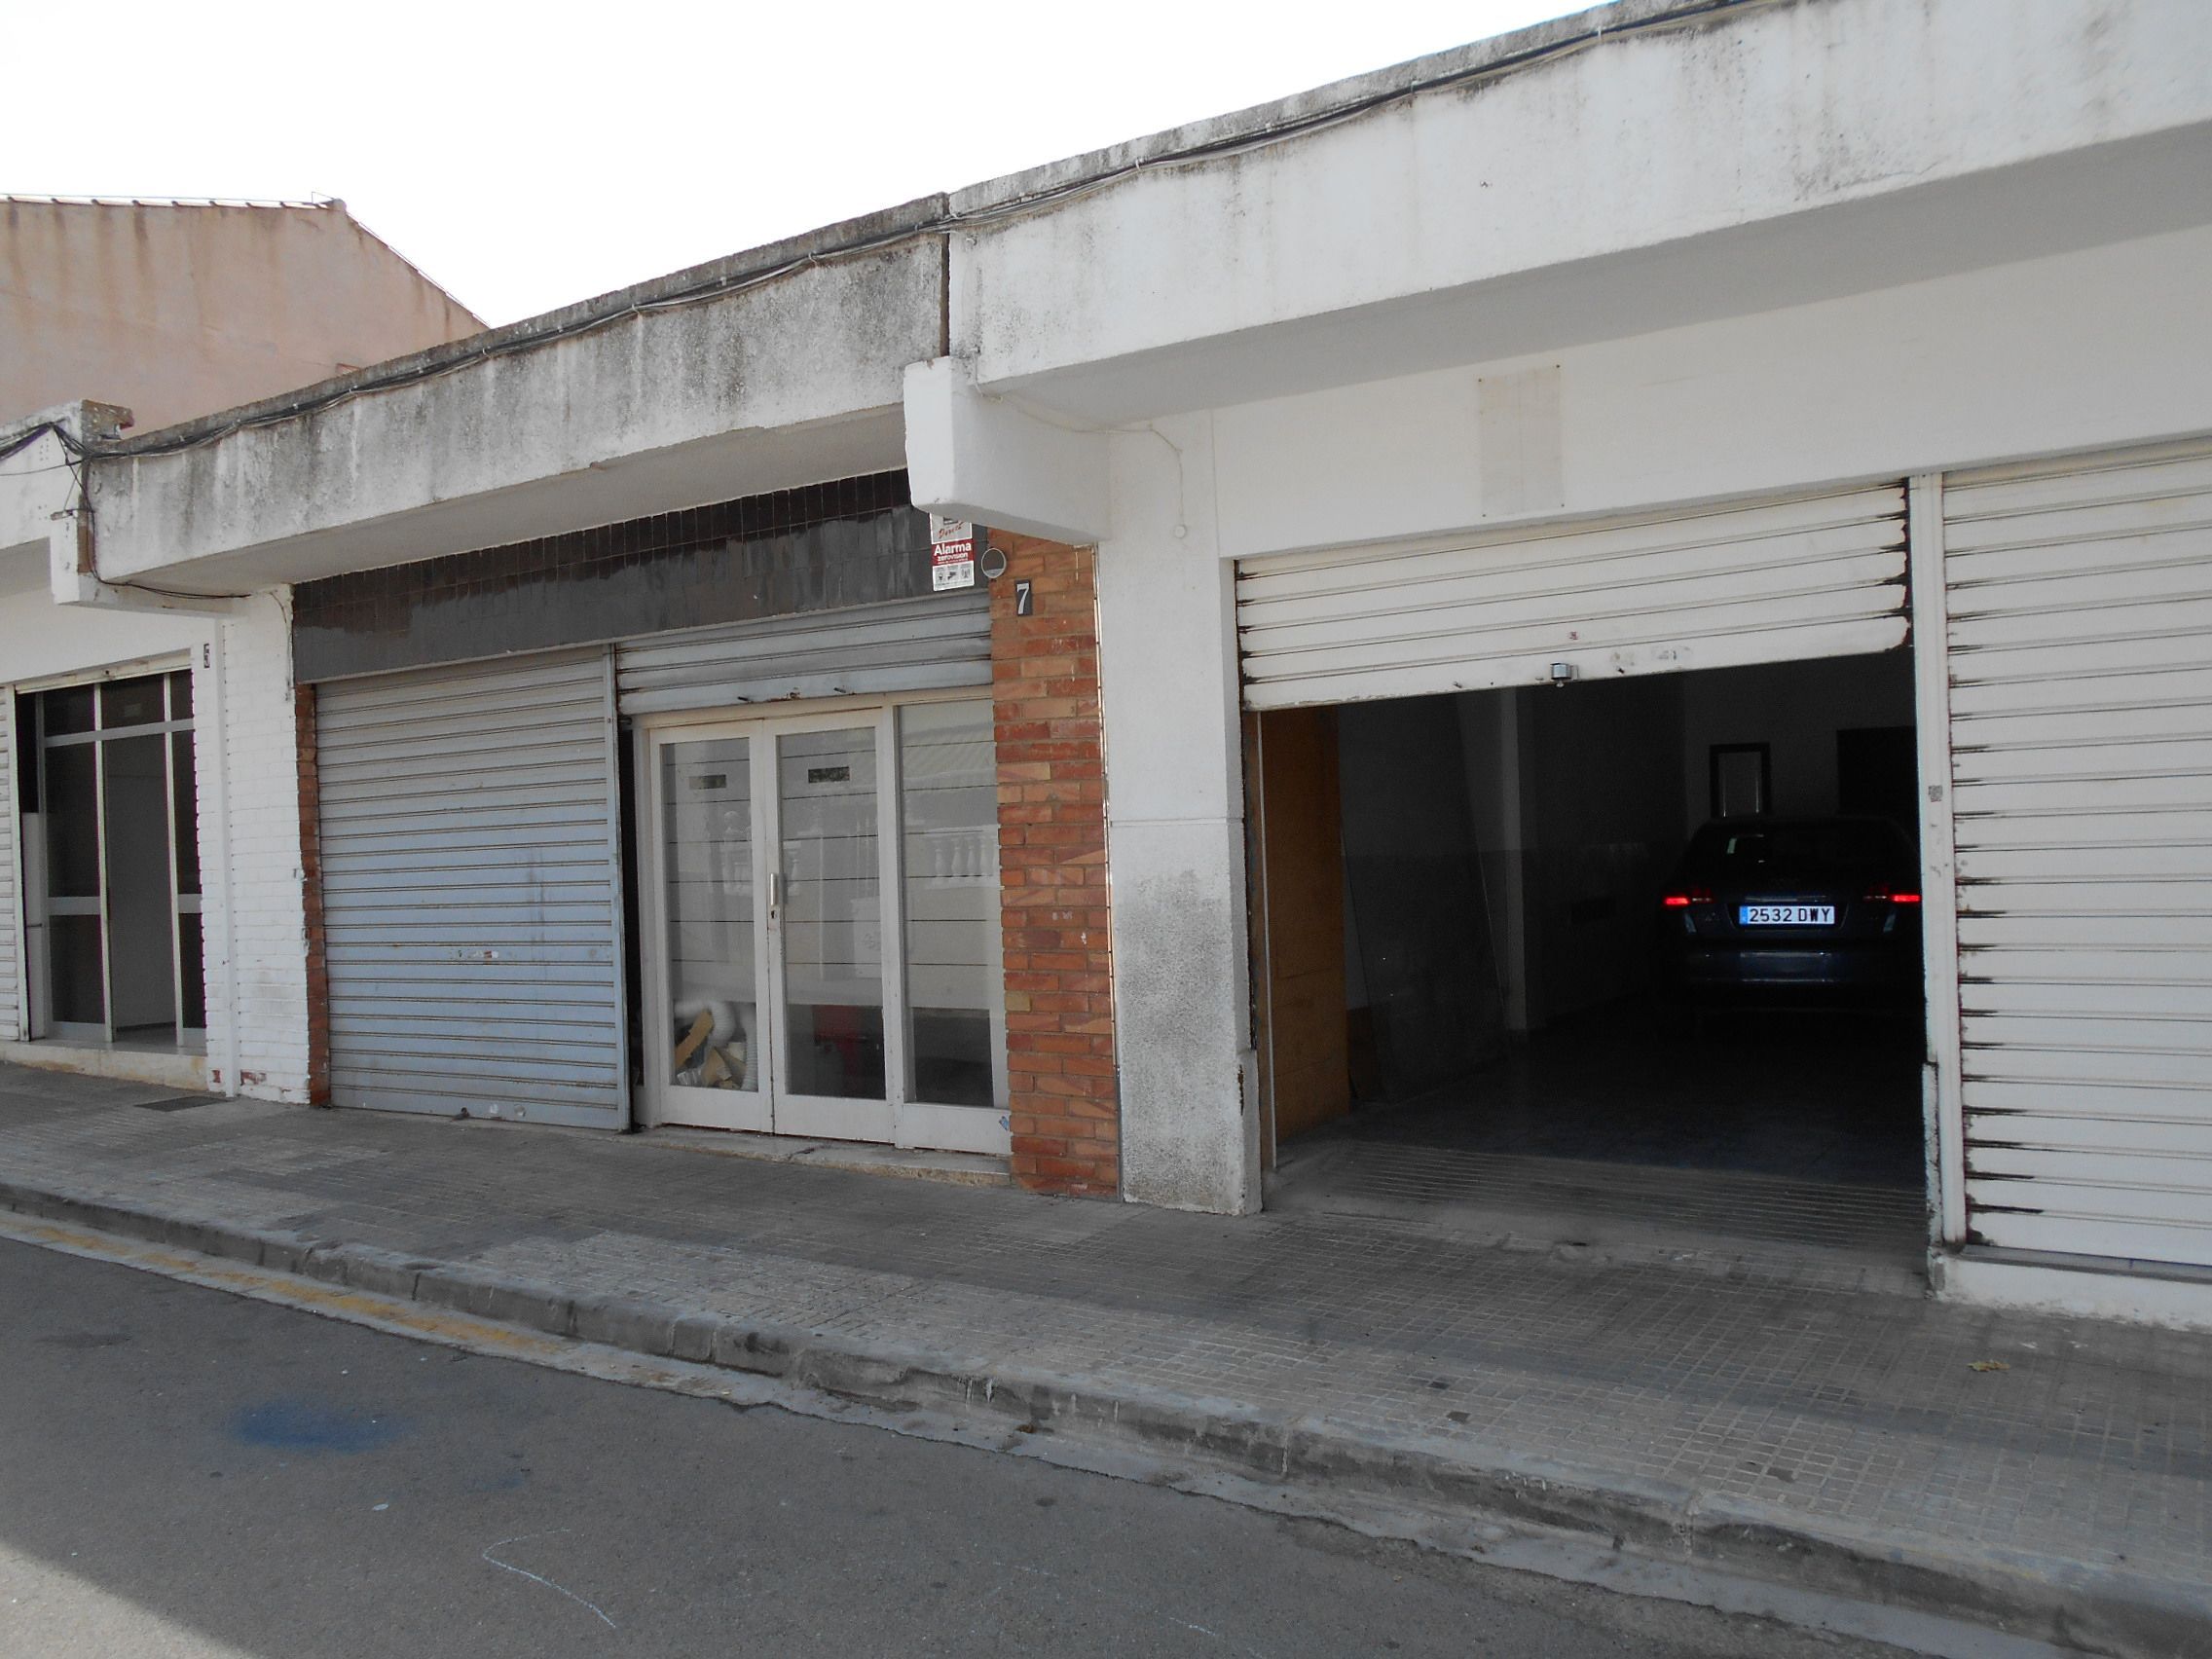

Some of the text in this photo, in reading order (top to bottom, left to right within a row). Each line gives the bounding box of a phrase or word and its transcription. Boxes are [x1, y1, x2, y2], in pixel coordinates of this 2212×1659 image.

[934, 542, 972, 556] Alarma
[1016, 583, 1029, 614] 7
[1750, 907, 1830, 922] 2532 DWY
